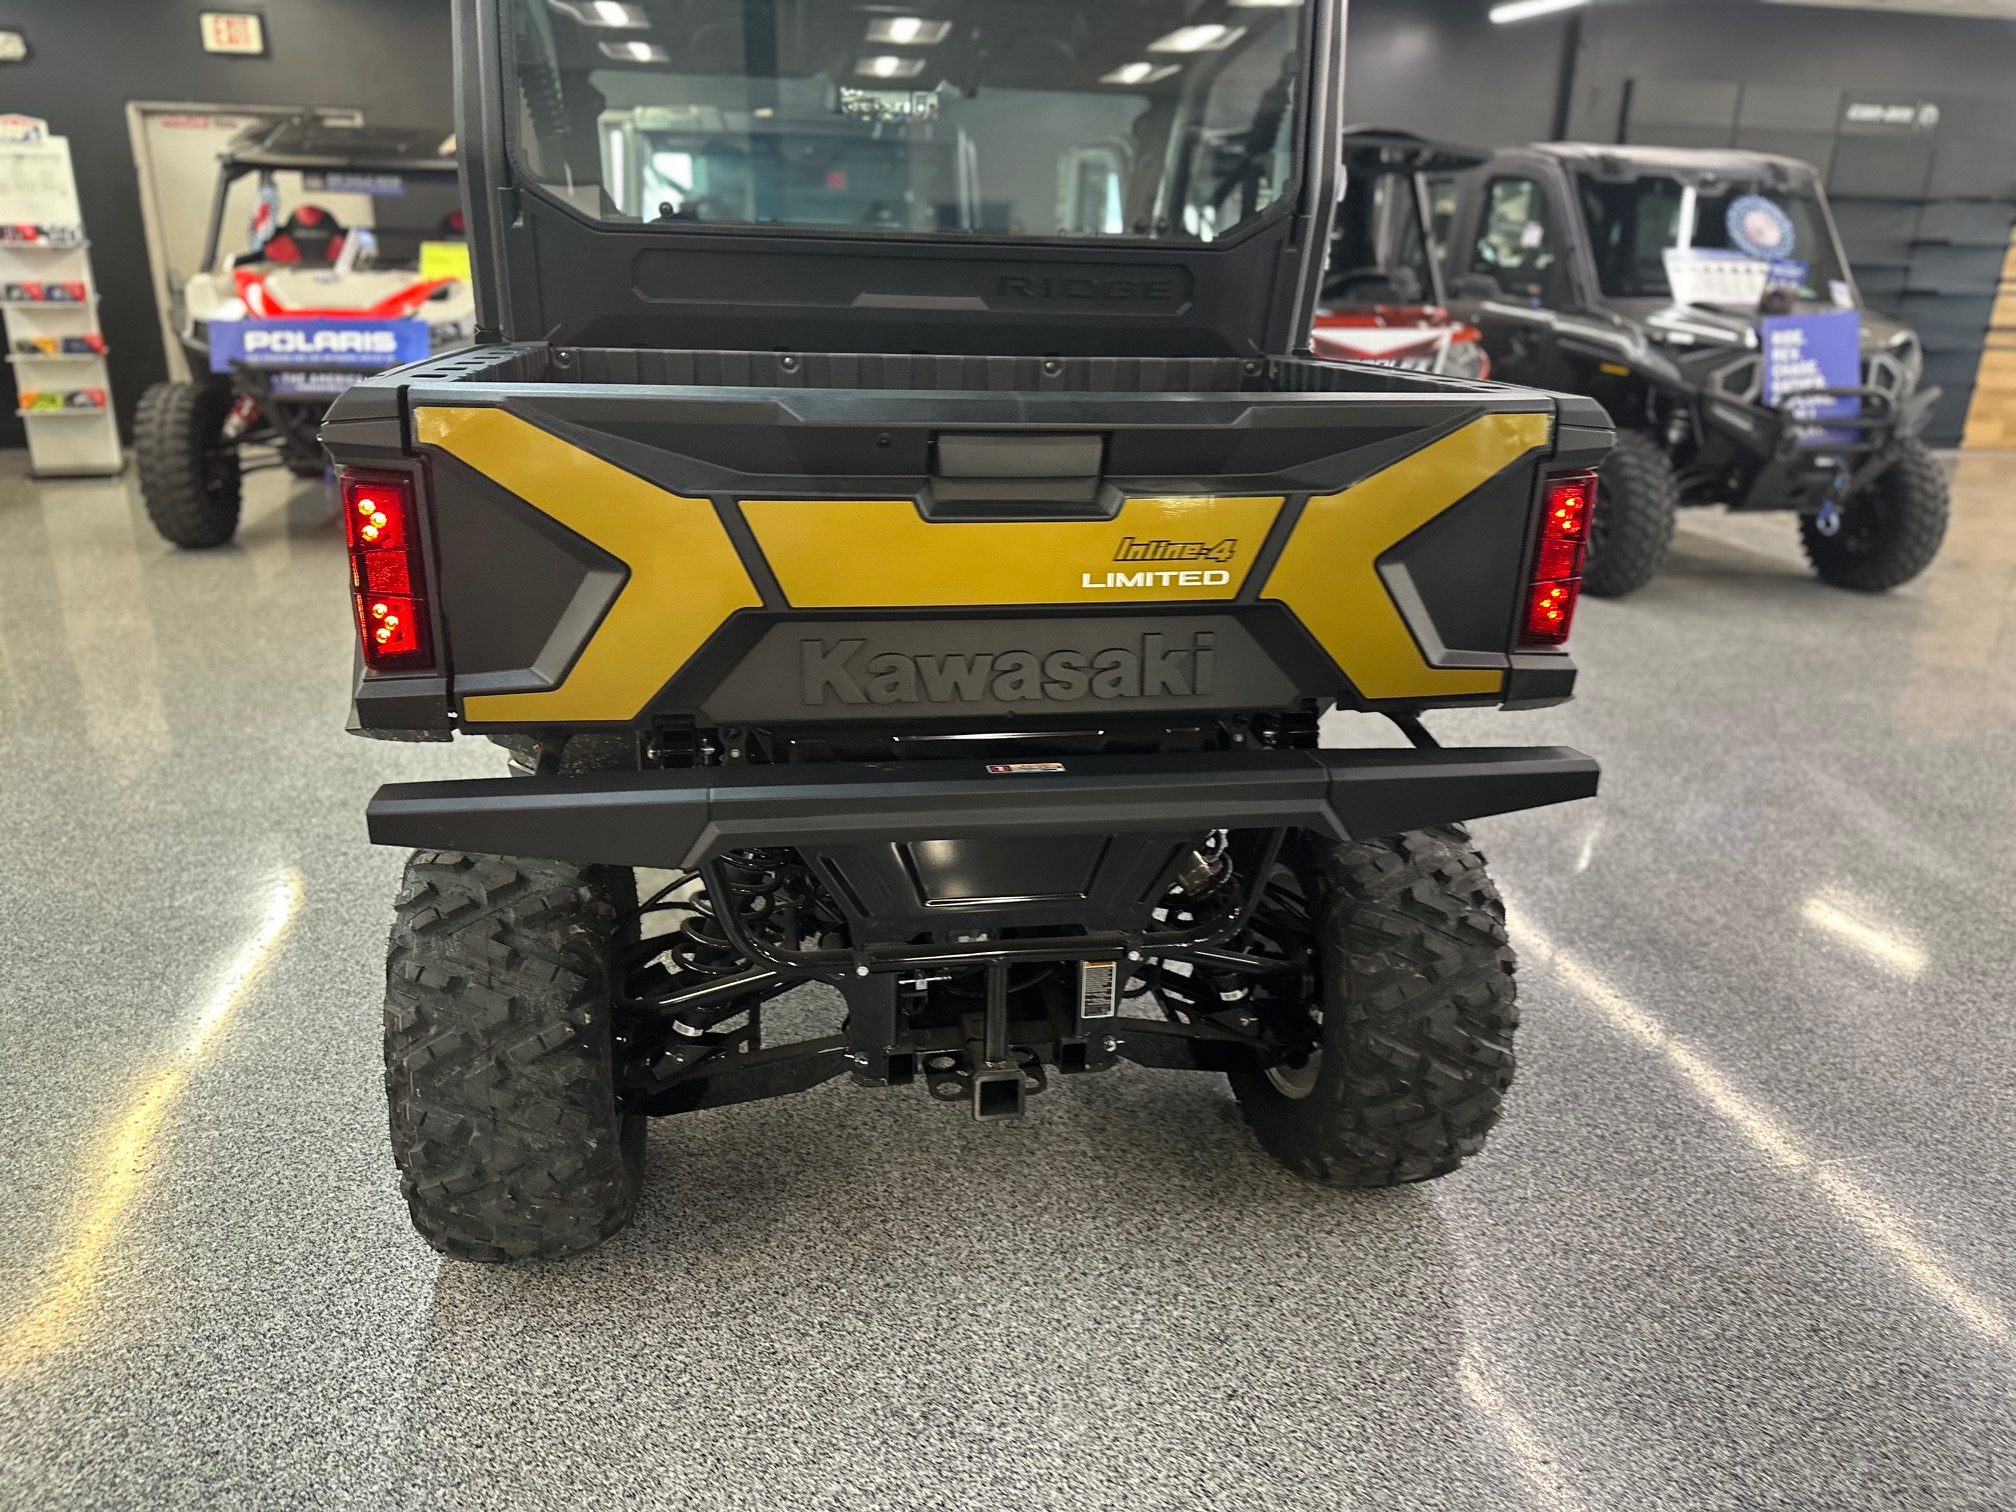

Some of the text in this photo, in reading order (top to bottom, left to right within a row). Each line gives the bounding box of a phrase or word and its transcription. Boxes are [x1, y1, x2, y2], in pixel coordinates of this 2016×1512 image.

[212, 15, 251, 47] EXIT
[998, 276, 1174, 300] RIDGE
[244, 331, 398, 352] POLARIS
[1113, 536, 1238, 563] Inline-4
[1082, 570, 1230, 588] LIMITED
[801, 631, 1215, 705] Kawasaki
